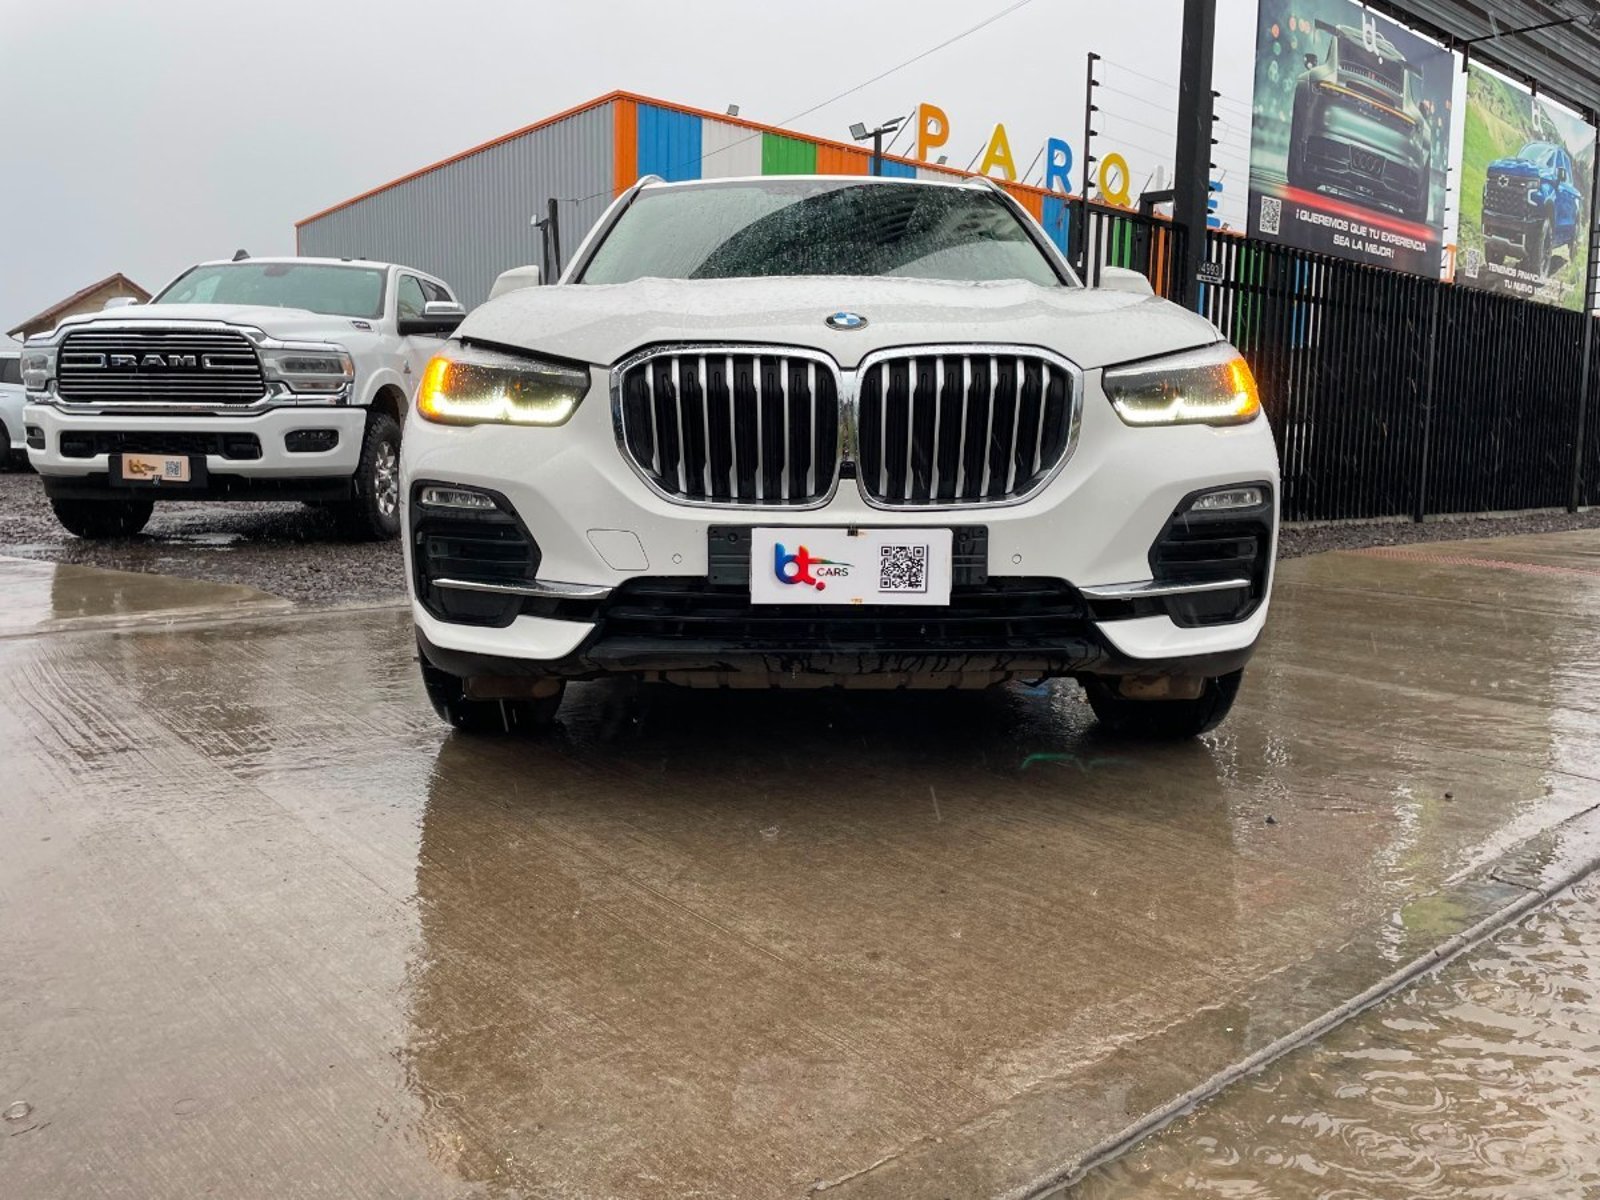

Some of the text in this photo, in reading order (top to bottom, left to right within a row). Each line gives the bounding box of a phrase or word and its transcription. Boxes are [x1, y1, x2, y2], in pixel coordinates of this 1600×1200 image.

[1350, 222, 1367, 237] QUE
[1369, 227, 1380, 239] TU
[1381, 231, 1427, 252] EXPERIENCIA
[1333, 234, 1395, 259] SEA LA MEJOR!
[1488, 262, 1517, 277] TENEMOS
[1504, 279, 1513, 289] TU
[1513, 283, 1533, 294] NUEVO
[110, 354, 197, 366] RAM
[816, 567, 849, 577] CARS
